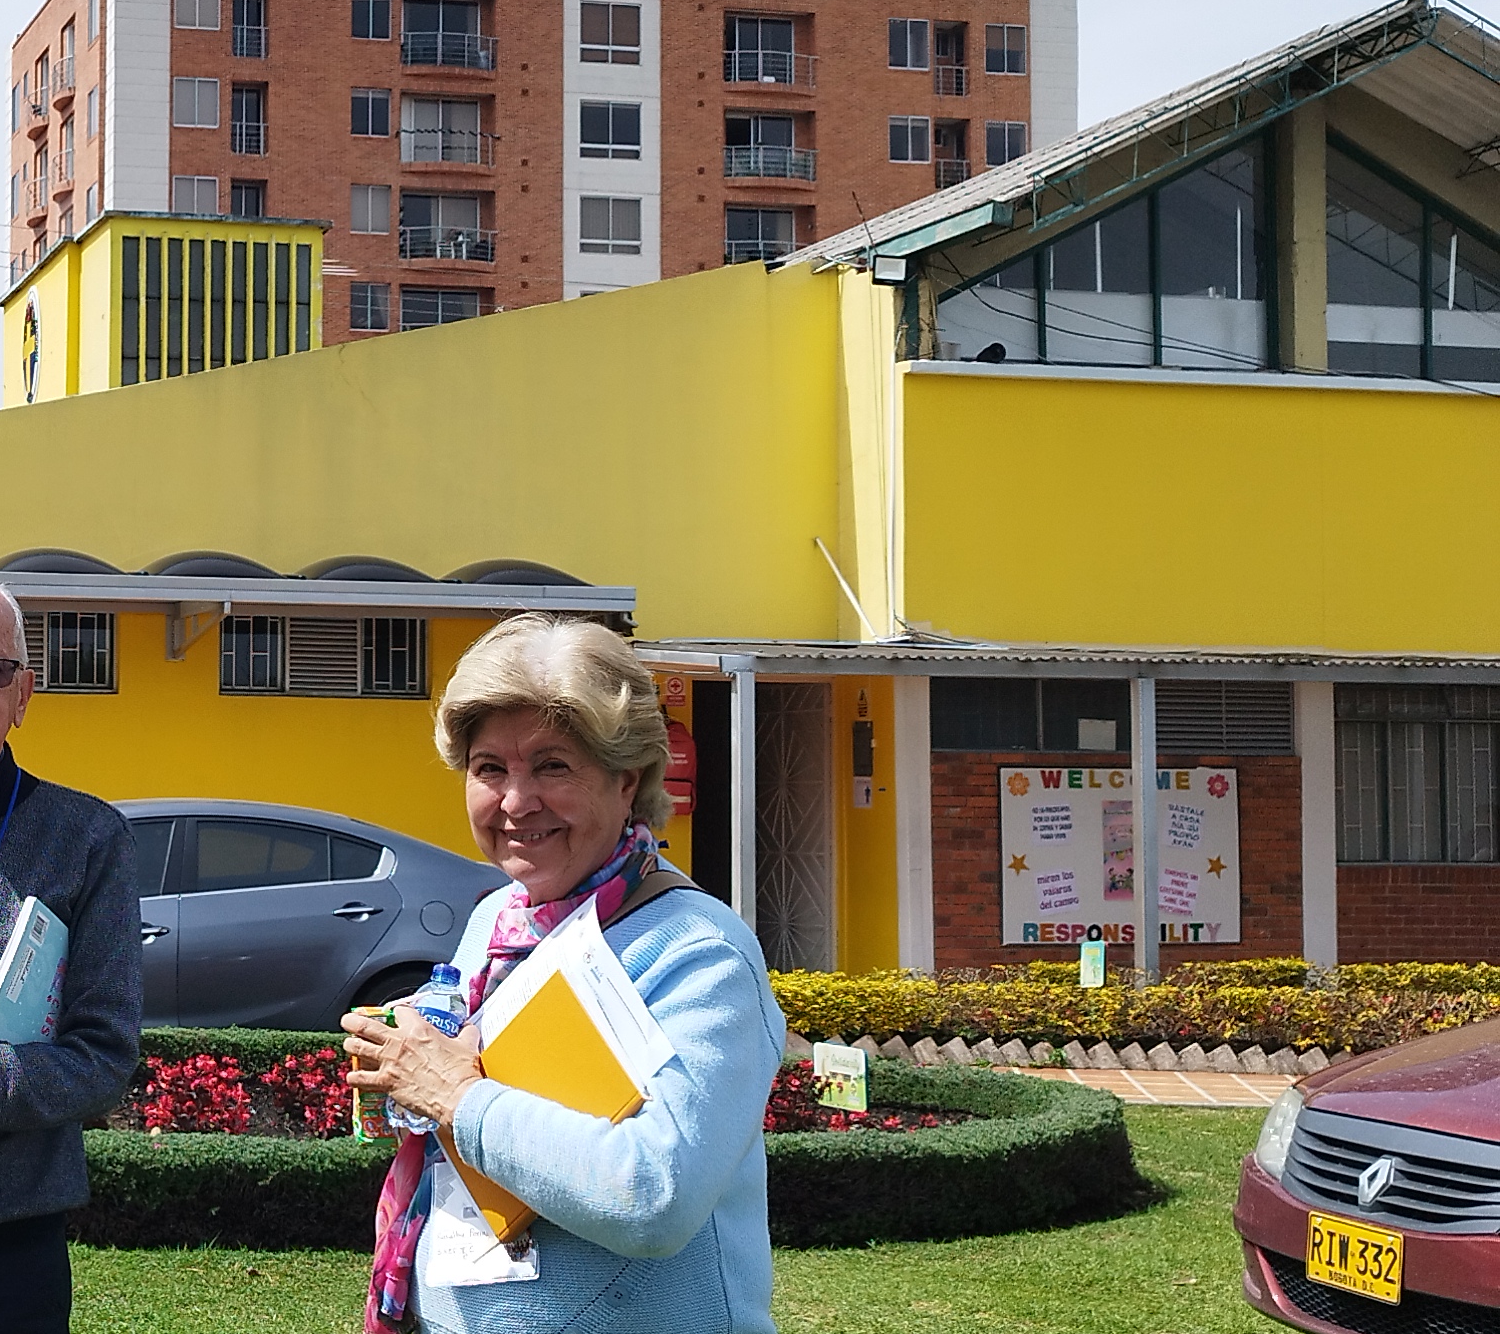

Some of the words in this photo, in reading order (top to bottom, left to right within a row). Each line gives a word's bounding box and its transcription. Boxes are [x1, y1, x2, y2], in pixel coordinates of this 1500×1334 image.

[1040, 770, 1191, 790] WELCME
[1023, 923, 1222, 942] RESPONSILITY
[1311, 1226, 1350, 1272] RIW
[1356, 1237, 1397, 1285] 332
[1328, 1269, 1357, 1288] BOGOTA
